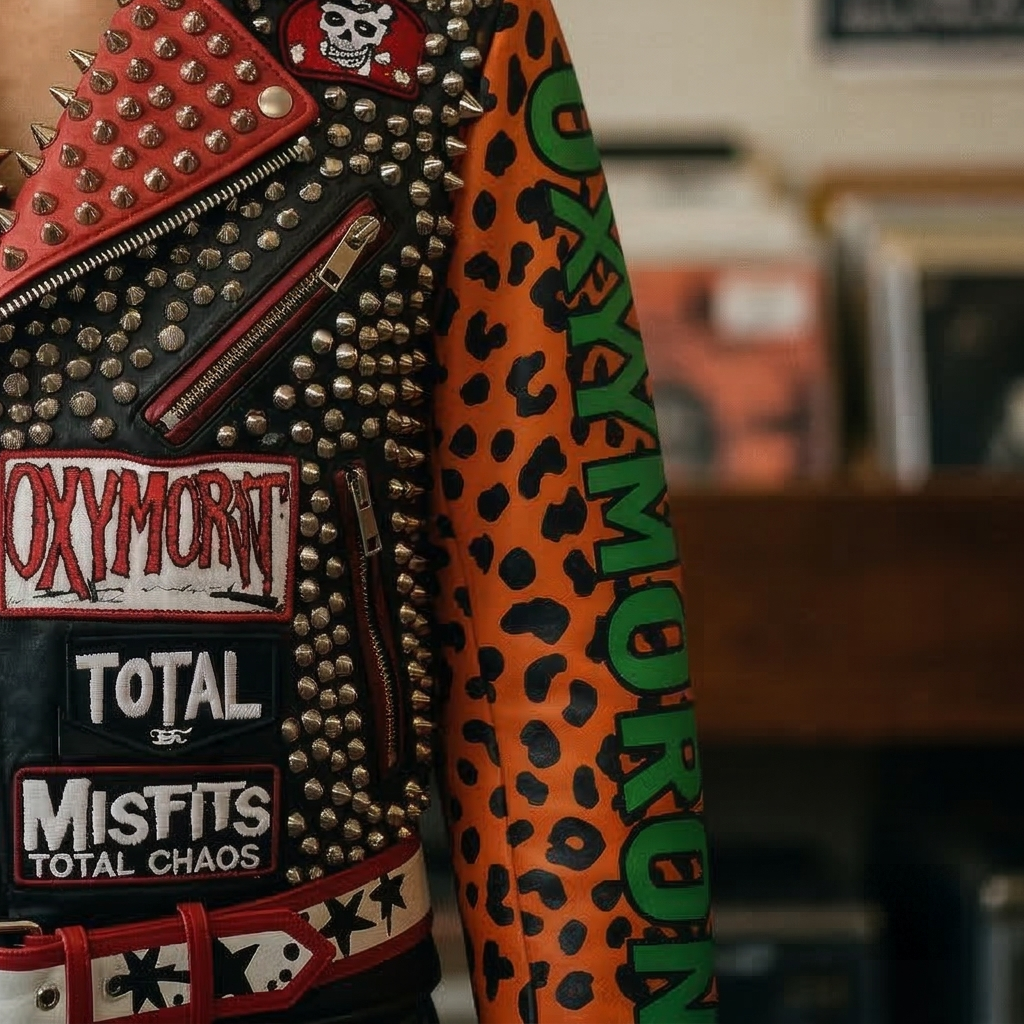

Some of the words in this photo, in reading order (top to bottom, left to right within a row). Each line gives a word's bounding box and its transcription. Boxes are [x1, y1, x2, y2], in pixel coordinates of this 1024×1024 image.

[76, 650, 263, 727] TOTAL
[21, 777, 272, 852] MISFITS
[27, 852, 136, 879] TOTAL
[149, 843, 262, 876] CHAOS
